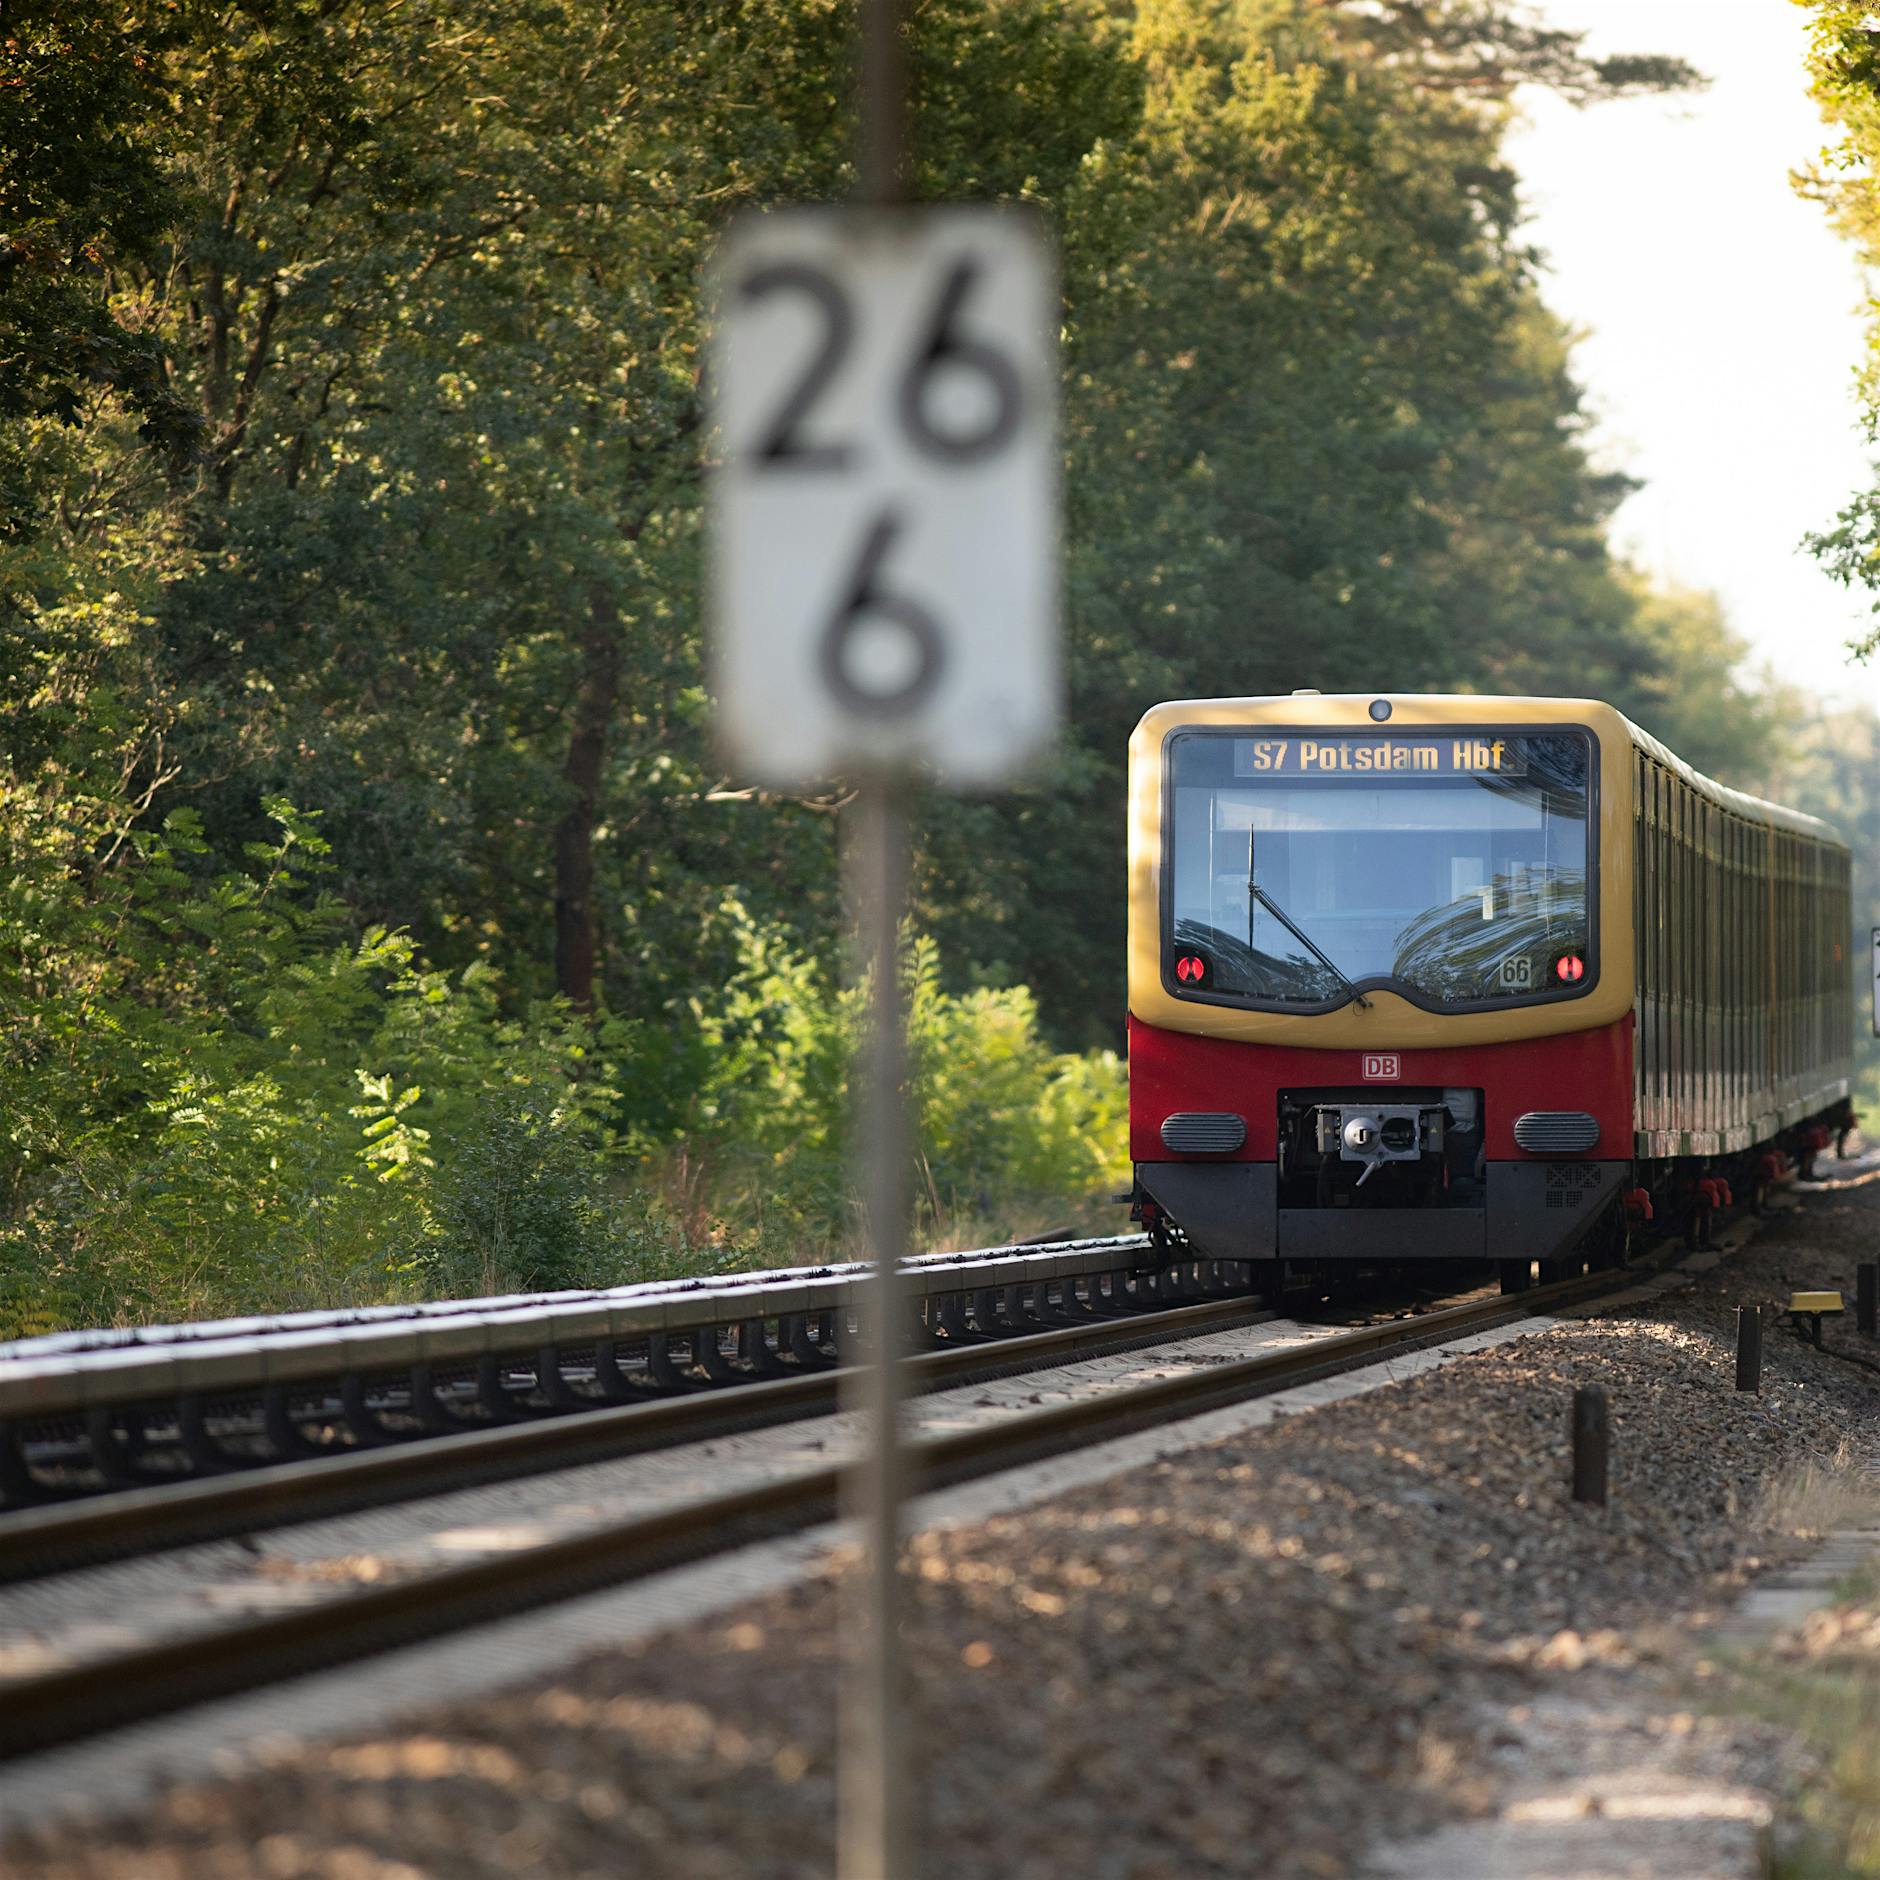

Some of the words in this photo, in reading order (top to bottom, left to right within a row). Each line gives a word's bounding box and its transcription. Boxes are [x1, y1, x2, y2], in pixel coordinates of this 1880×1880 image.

[738, 253, 1025, 473] 26
[817, 506, 948, 720] 6
[1253, 741, 1288, 770] S7
[1300, 741, 1438, 770] Potsdam
[1503, 959, 1529, 983] 66
[1367, 1057, 1396, 1076] DB
